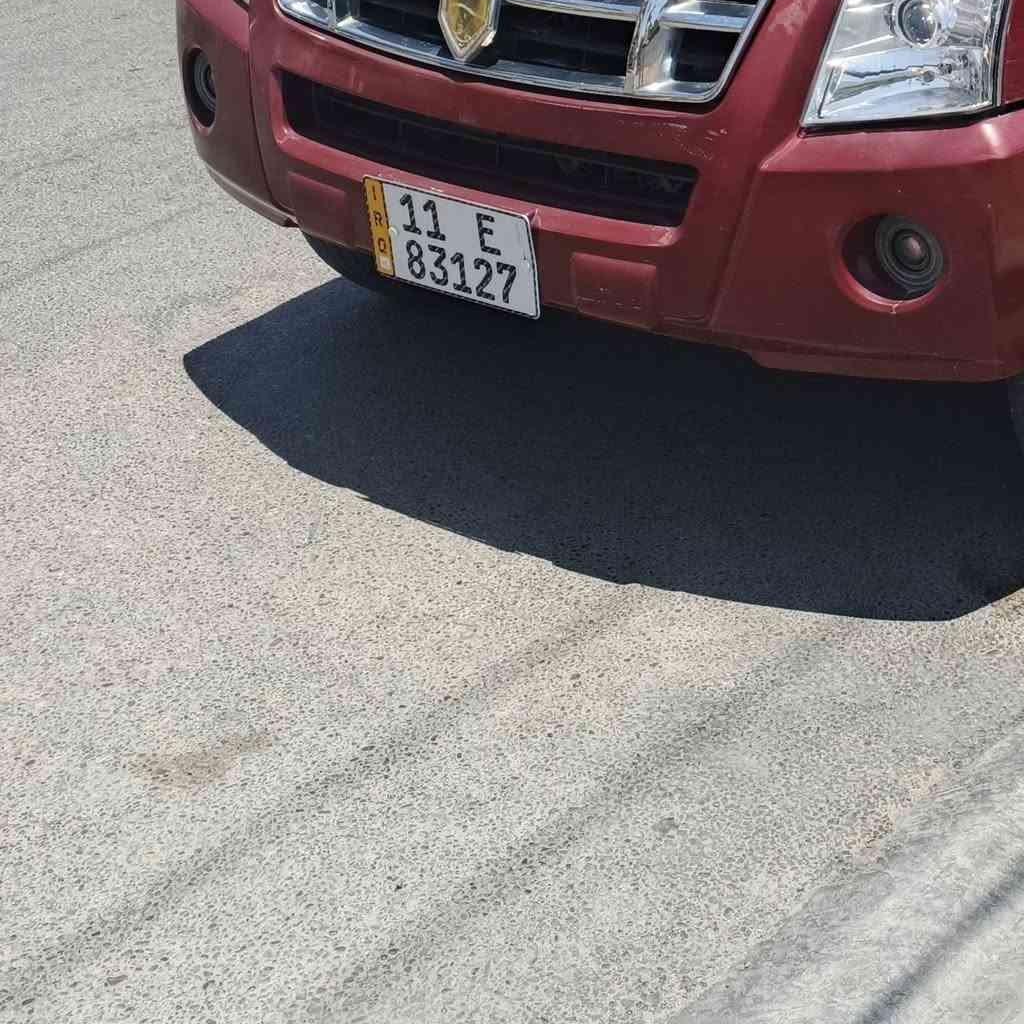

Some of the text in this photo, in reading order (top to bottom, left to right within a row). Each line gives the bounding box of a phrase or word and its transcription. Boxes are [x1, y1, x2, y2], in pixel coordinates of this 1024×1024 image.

[400, 193, 501, 256] 11 E
[405, 239, 517, 304] 83127
